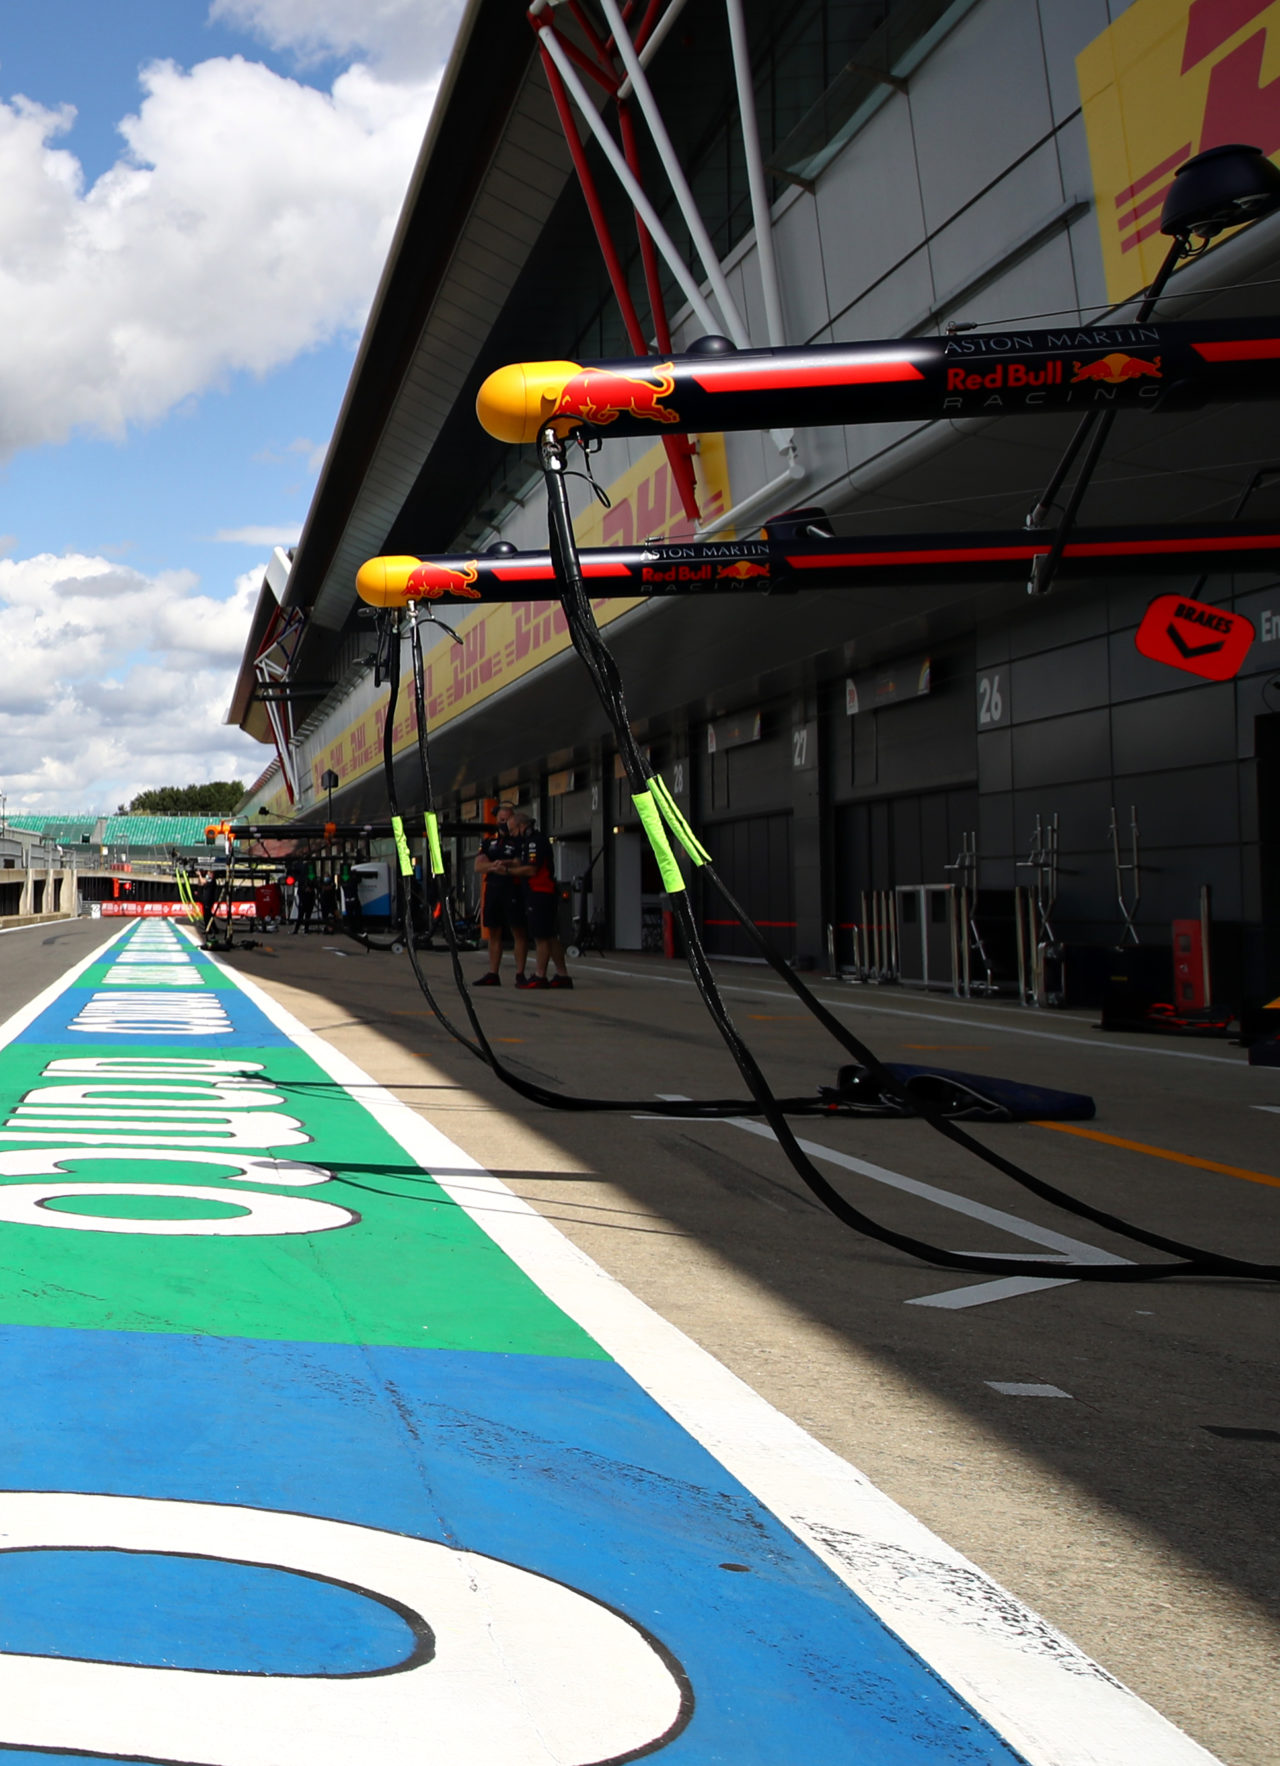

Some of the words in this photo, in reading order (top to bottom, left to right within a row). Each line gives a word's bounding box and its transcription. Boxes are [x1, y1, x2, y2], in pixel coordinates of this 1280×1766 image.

[945, 336, 1032, 354] ASTON
[1048, 328, 1160, 347] MARTIN
[947, 364, 1004, 391] Red
[1007, 361, 1062, 388] Bull
[943, 384, 1160, 409] RACING
[702, 544, 771, 557] MARTIN
[641, 565, 677, 583] Red
[678, 564, 713, 581] Bull
[1173, 604, 1234, 635] BRAKES
[979, 675, 1003, 724] 26
[793, 729, 808, 767] 27
